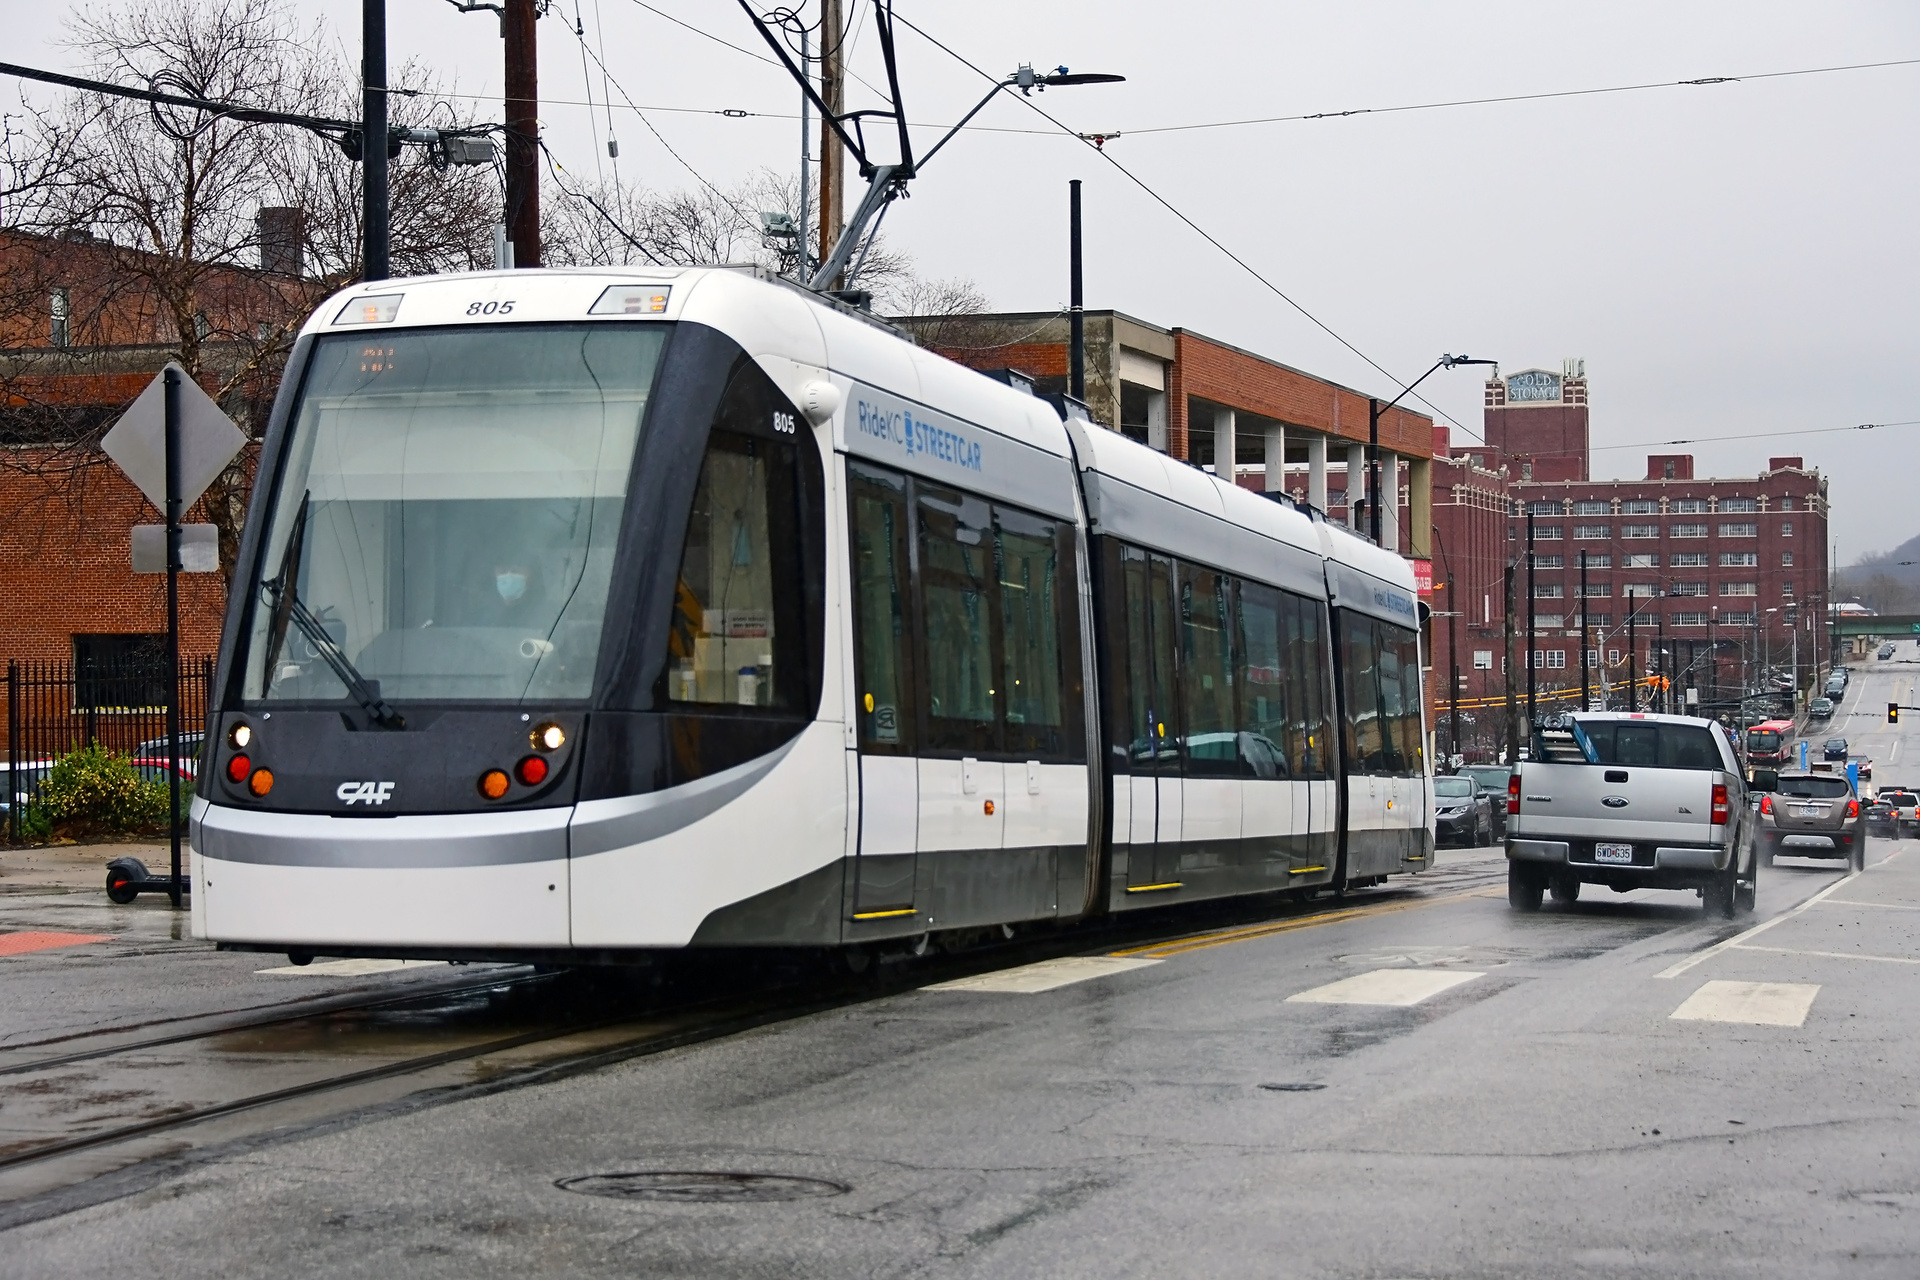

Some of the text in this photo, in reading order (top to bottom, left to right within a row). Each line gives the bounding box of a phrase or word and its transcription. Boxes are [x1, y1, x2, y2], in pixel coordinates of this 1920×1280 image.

[465, 301, 517, 317] 805
[1516, 374, 1552, 386] COLD
[1510, 386, 1559, 399] STORAGE
[773, 411, 795, 434] 805
[858, 400, 981, 472] RideKC STREETCAR
[336, 782, 396, 805] CAF
